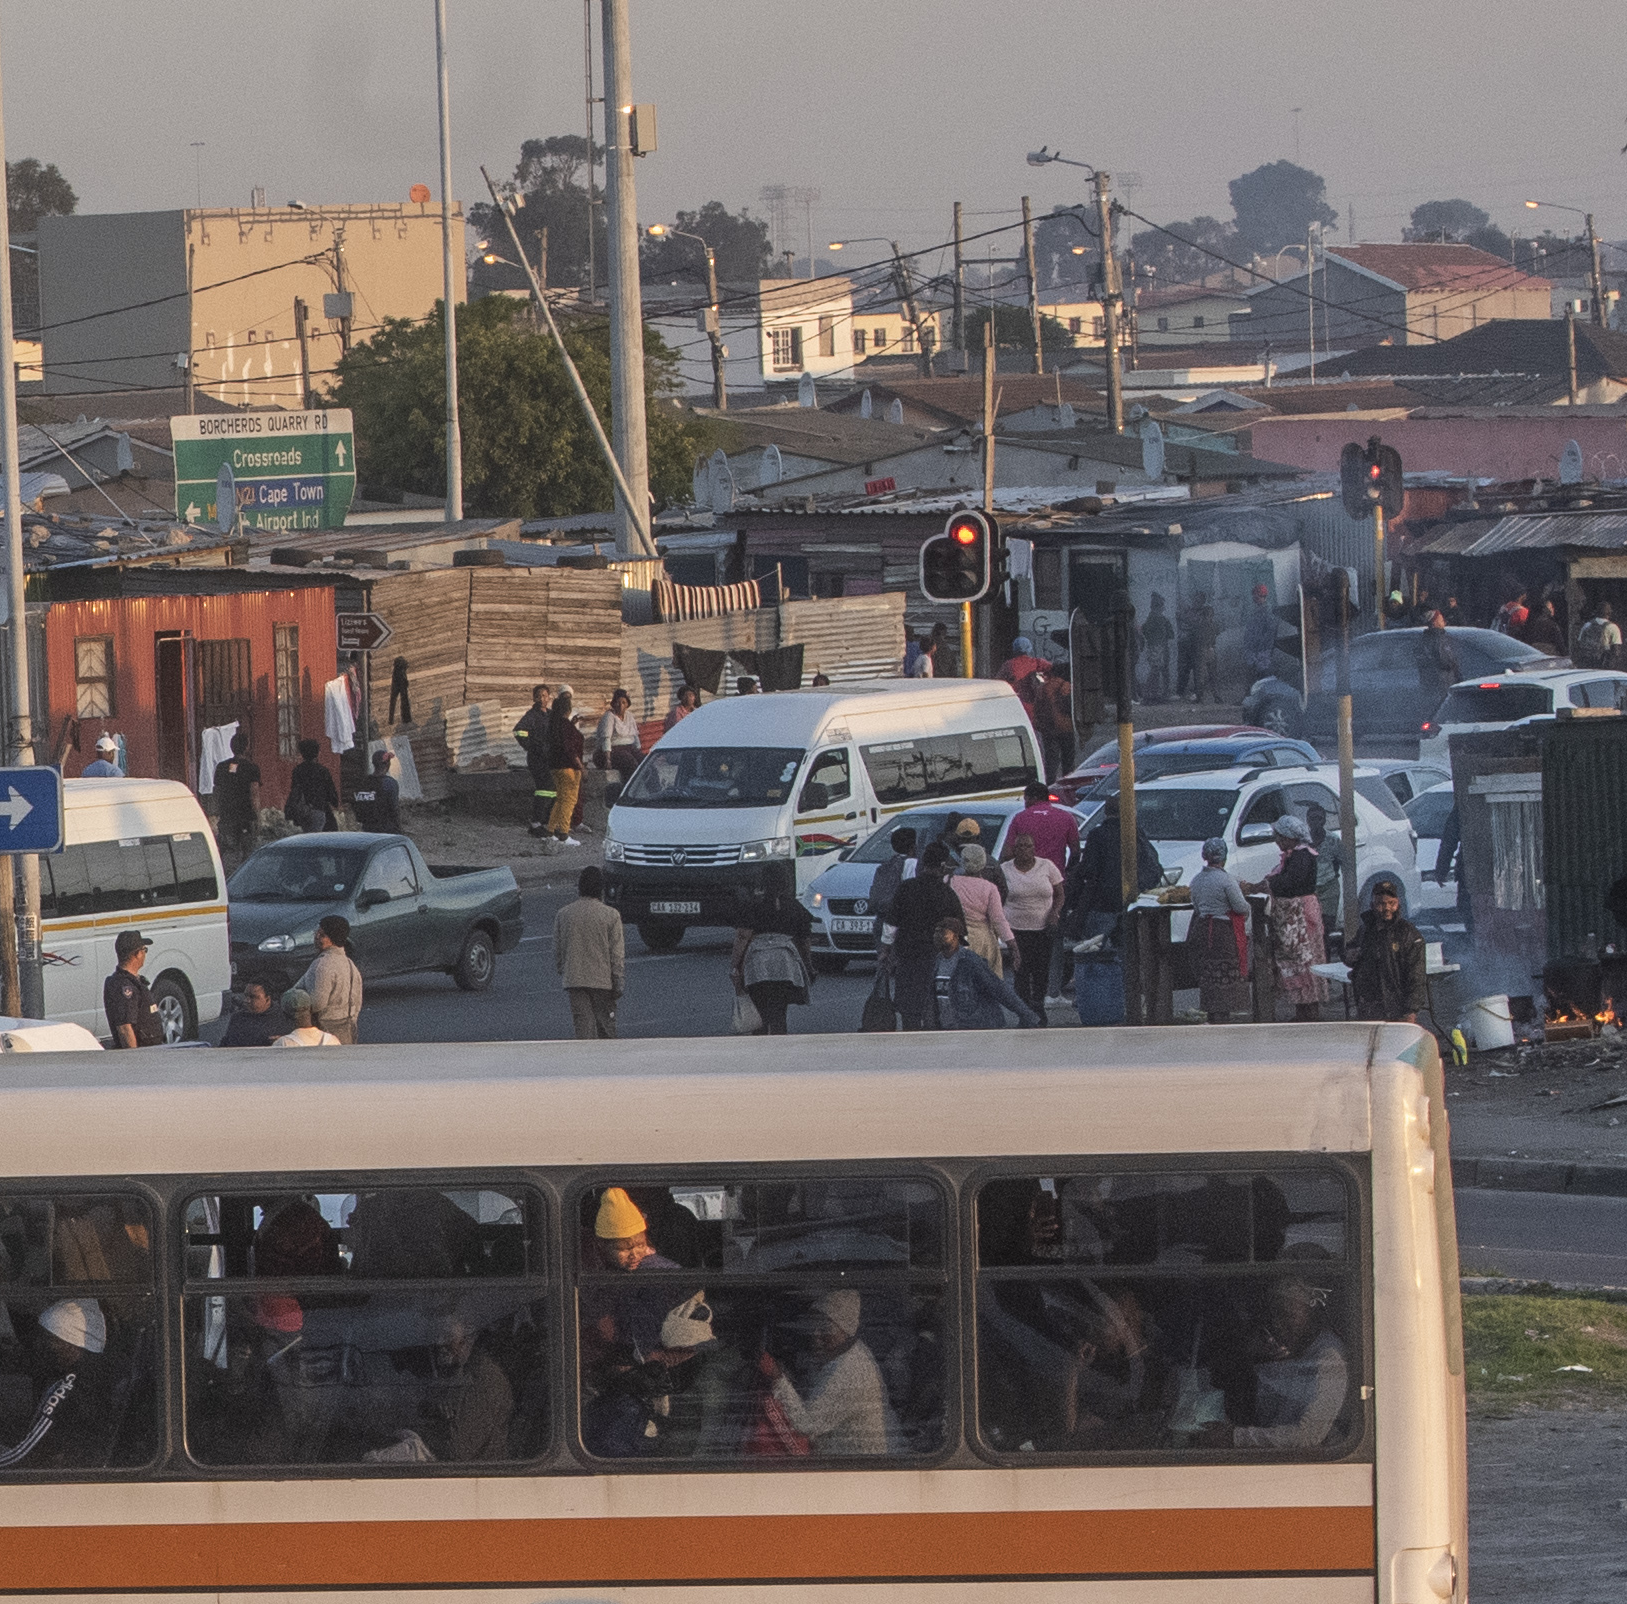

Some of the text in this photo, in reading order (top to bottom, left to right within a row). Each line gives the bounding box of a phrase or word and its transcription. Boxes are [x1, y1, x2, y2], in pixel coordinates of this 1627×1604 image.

[199, 413, 329, 436] BORCHERDS QUARRY RD
[233, 448, 302, 469] Crossroads
[259, 484, 288, 506] Cape
[293, 482, 325, 500] Town
[42, 1373, 76, 1415] adidas
